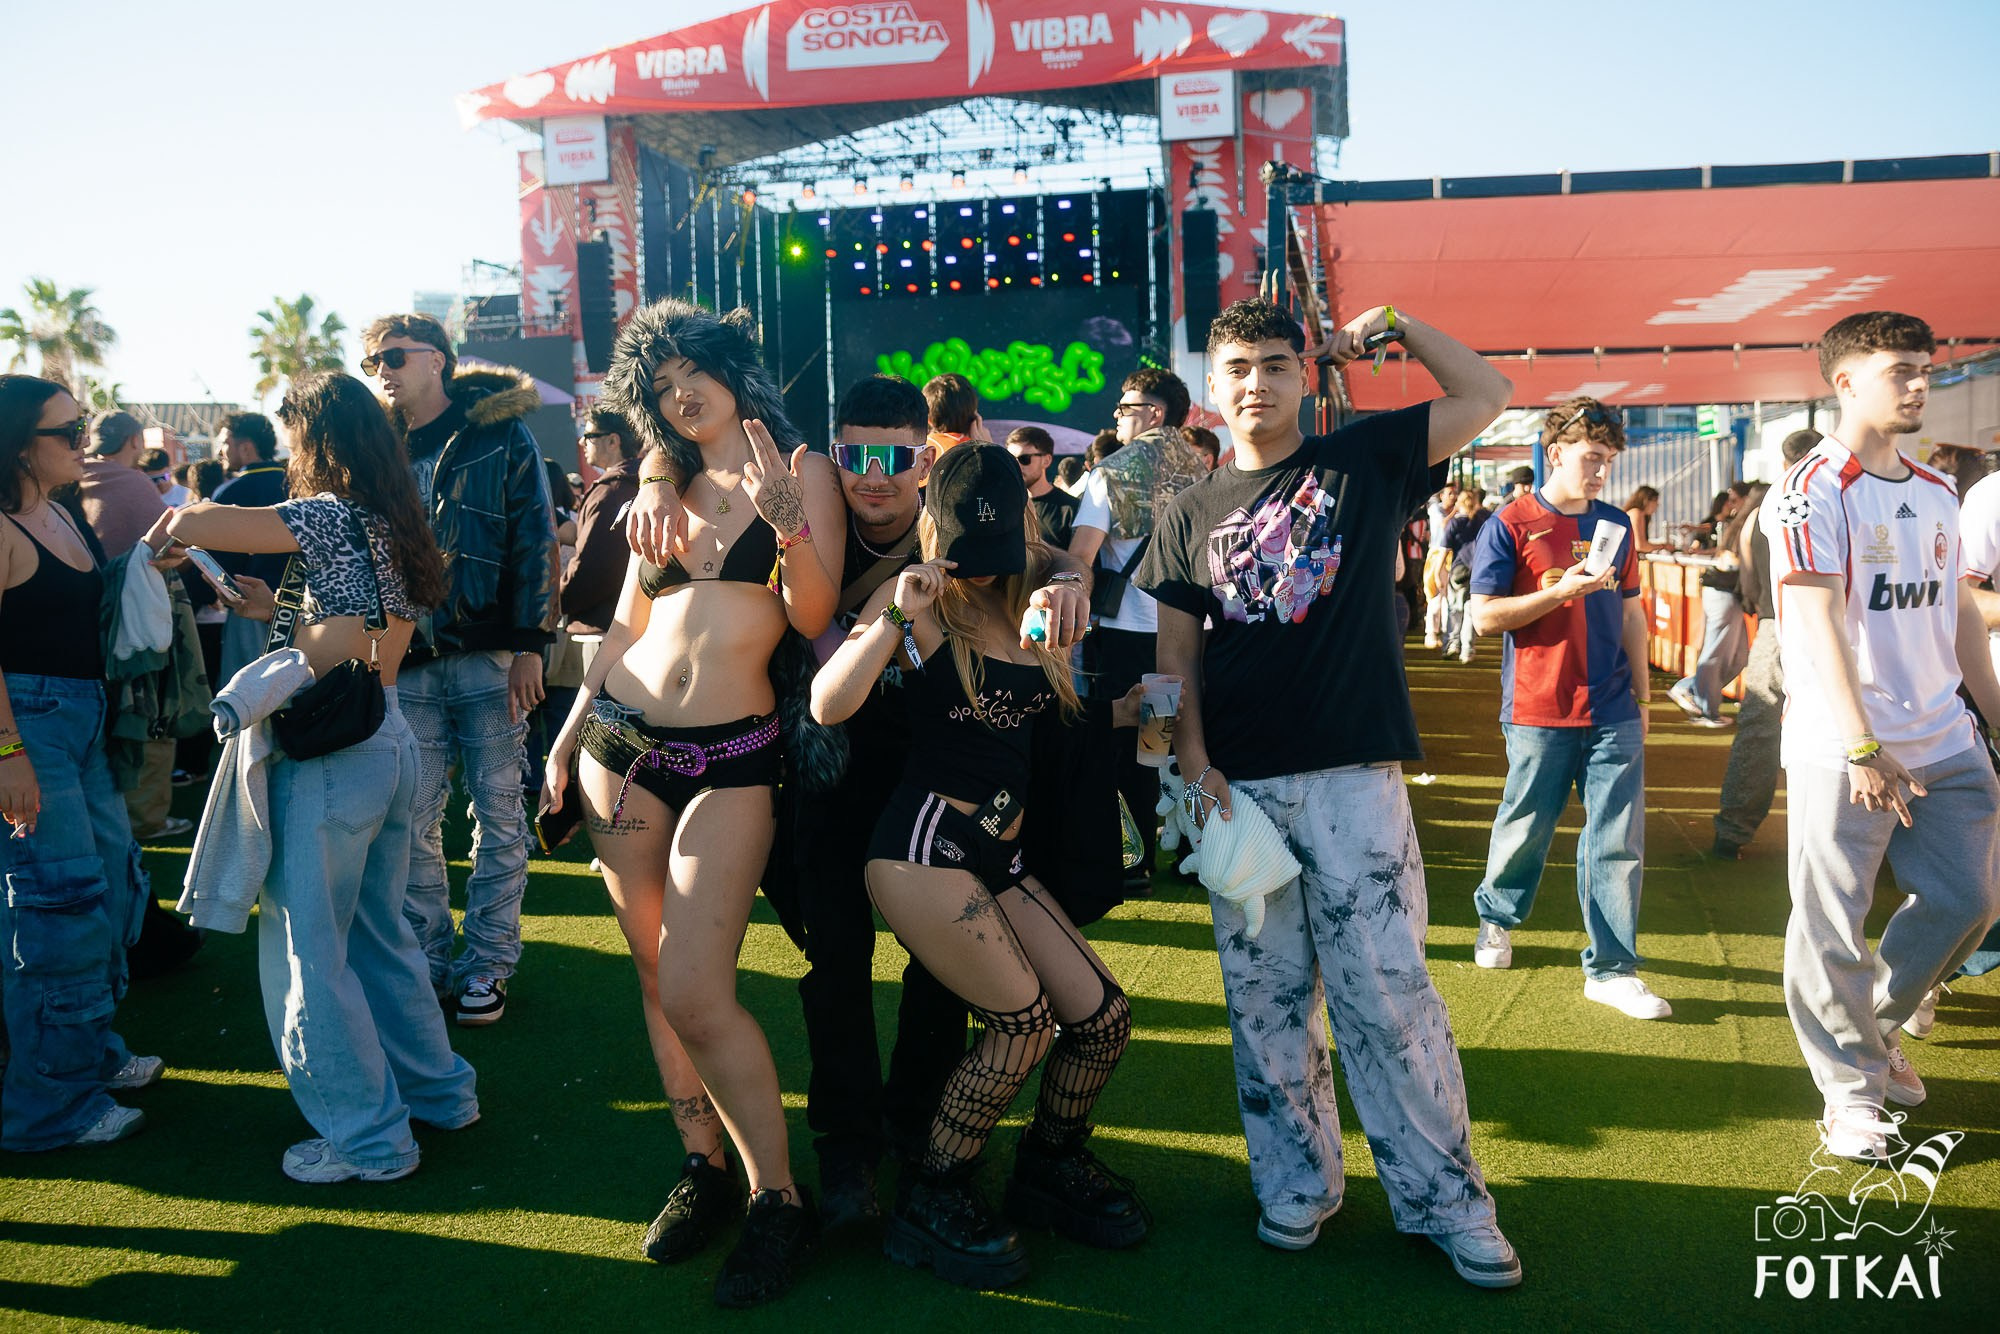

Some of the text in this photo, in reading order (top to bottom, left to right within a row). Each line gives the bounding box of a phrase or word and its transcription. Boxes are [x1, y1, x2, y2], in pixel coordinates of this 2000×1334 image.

[803, 3, 914, 30] COSTA
[803, 24, 945, 51] SONORA
[1010, 12, 1113, 51] VIBRA
[635, 44, 728, 80] VIBRA
[976, 497, 996, 522] LA
